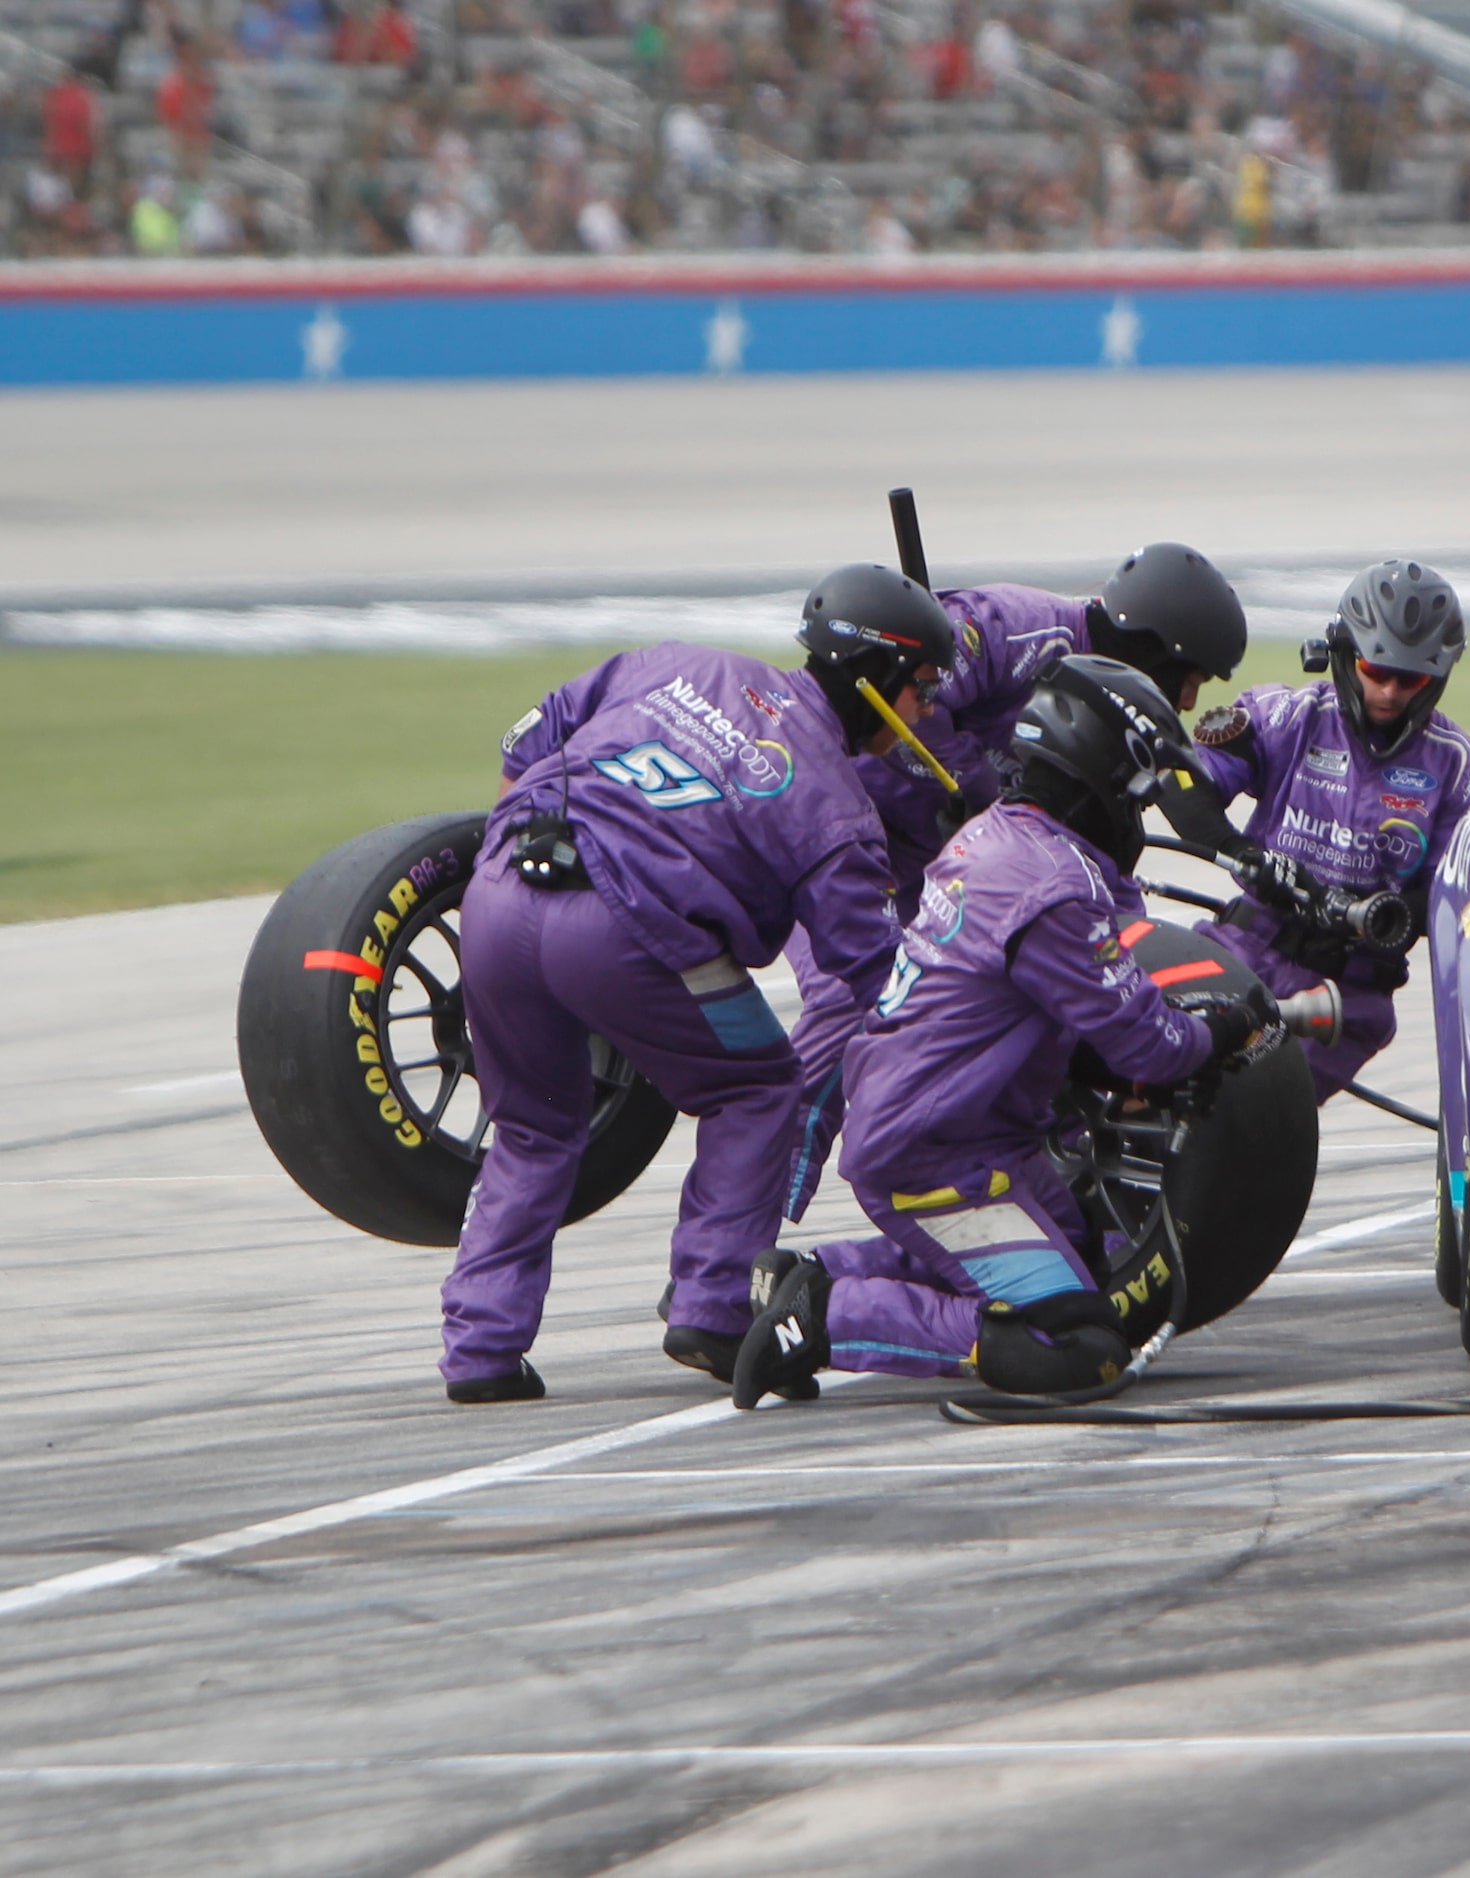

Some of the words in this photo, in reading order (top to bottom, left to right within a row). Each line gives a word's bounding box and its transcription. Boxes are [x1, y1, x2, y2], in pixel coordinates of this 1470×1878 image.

[645, 688, 735, 759] (rimegepant)
[662, 675, 747, 748] Nurtec
[738, 744, 781, 784] ODT
[592, 740, 723, 809] 51
[1296, 772, 1348, 793] GOODYEAR
[1389, 768, 1428, 788] Ford
[1276, 830, 1376, 871] (rimegepant)
[1282, 803, 1370, 851] Nurtec
[1373, 831, 1418, 860] ODT
[347, 876, 423, 1148] GOODYEAR
[409, 847, 459, 896] RR-3
[750, 1267, 775, 1307] N
[774, 1314, 805, 1354] N
